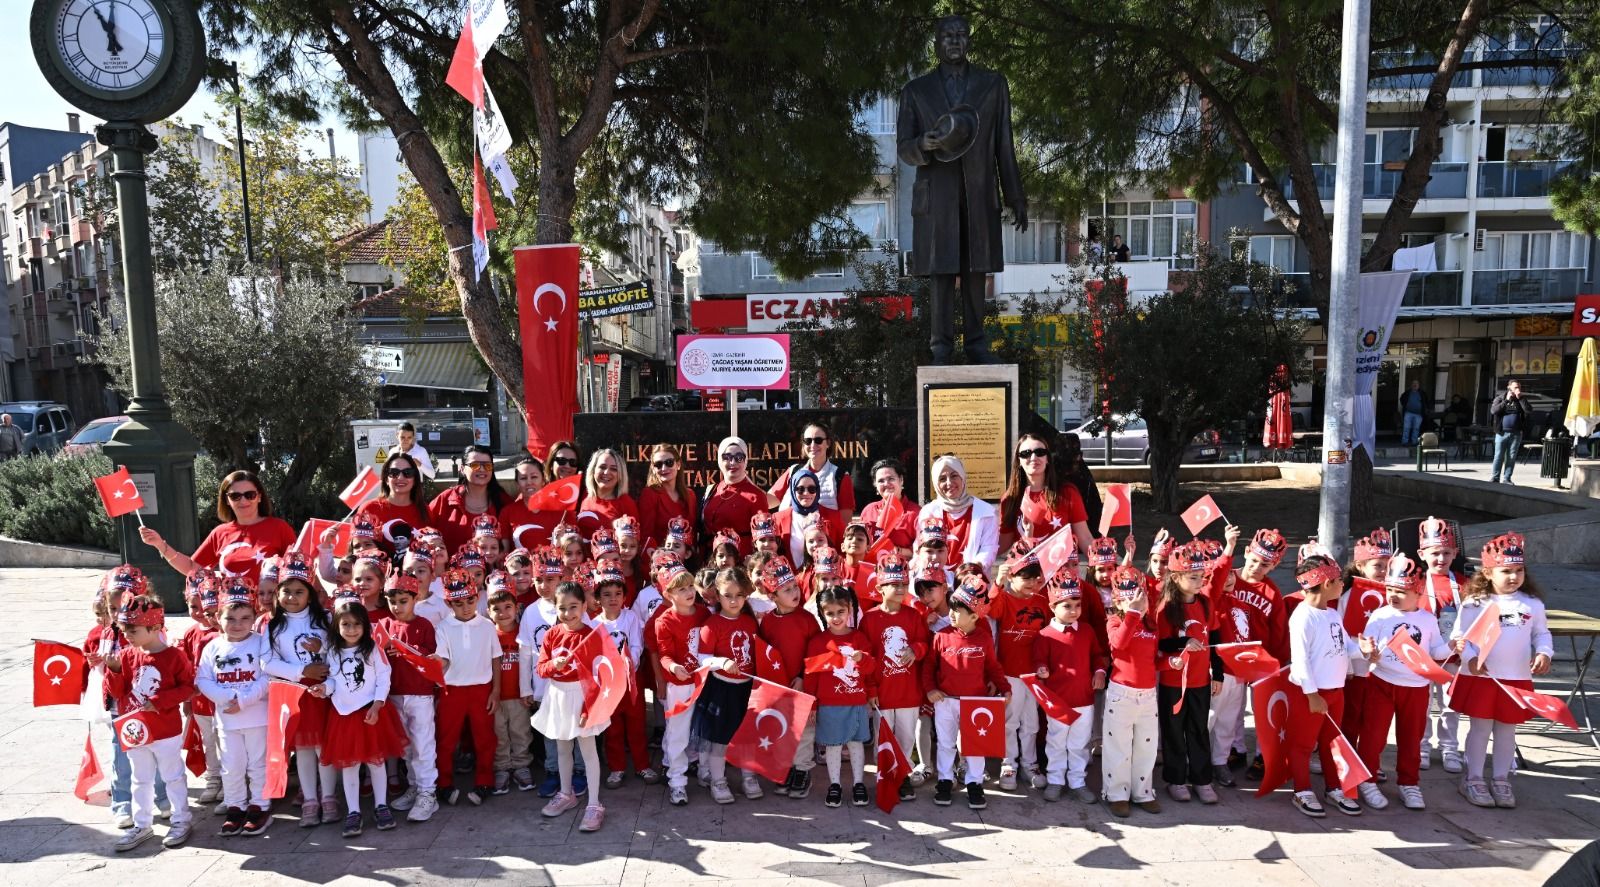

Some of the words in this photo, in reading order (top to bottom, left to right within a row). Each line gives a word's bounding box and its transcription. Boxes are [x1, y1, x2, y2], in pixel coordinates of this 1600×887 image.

[598, 295, 606, 305] &
[608, 288, 649, 305] KÖFTE
[1581, 308, 1600, 323] S
